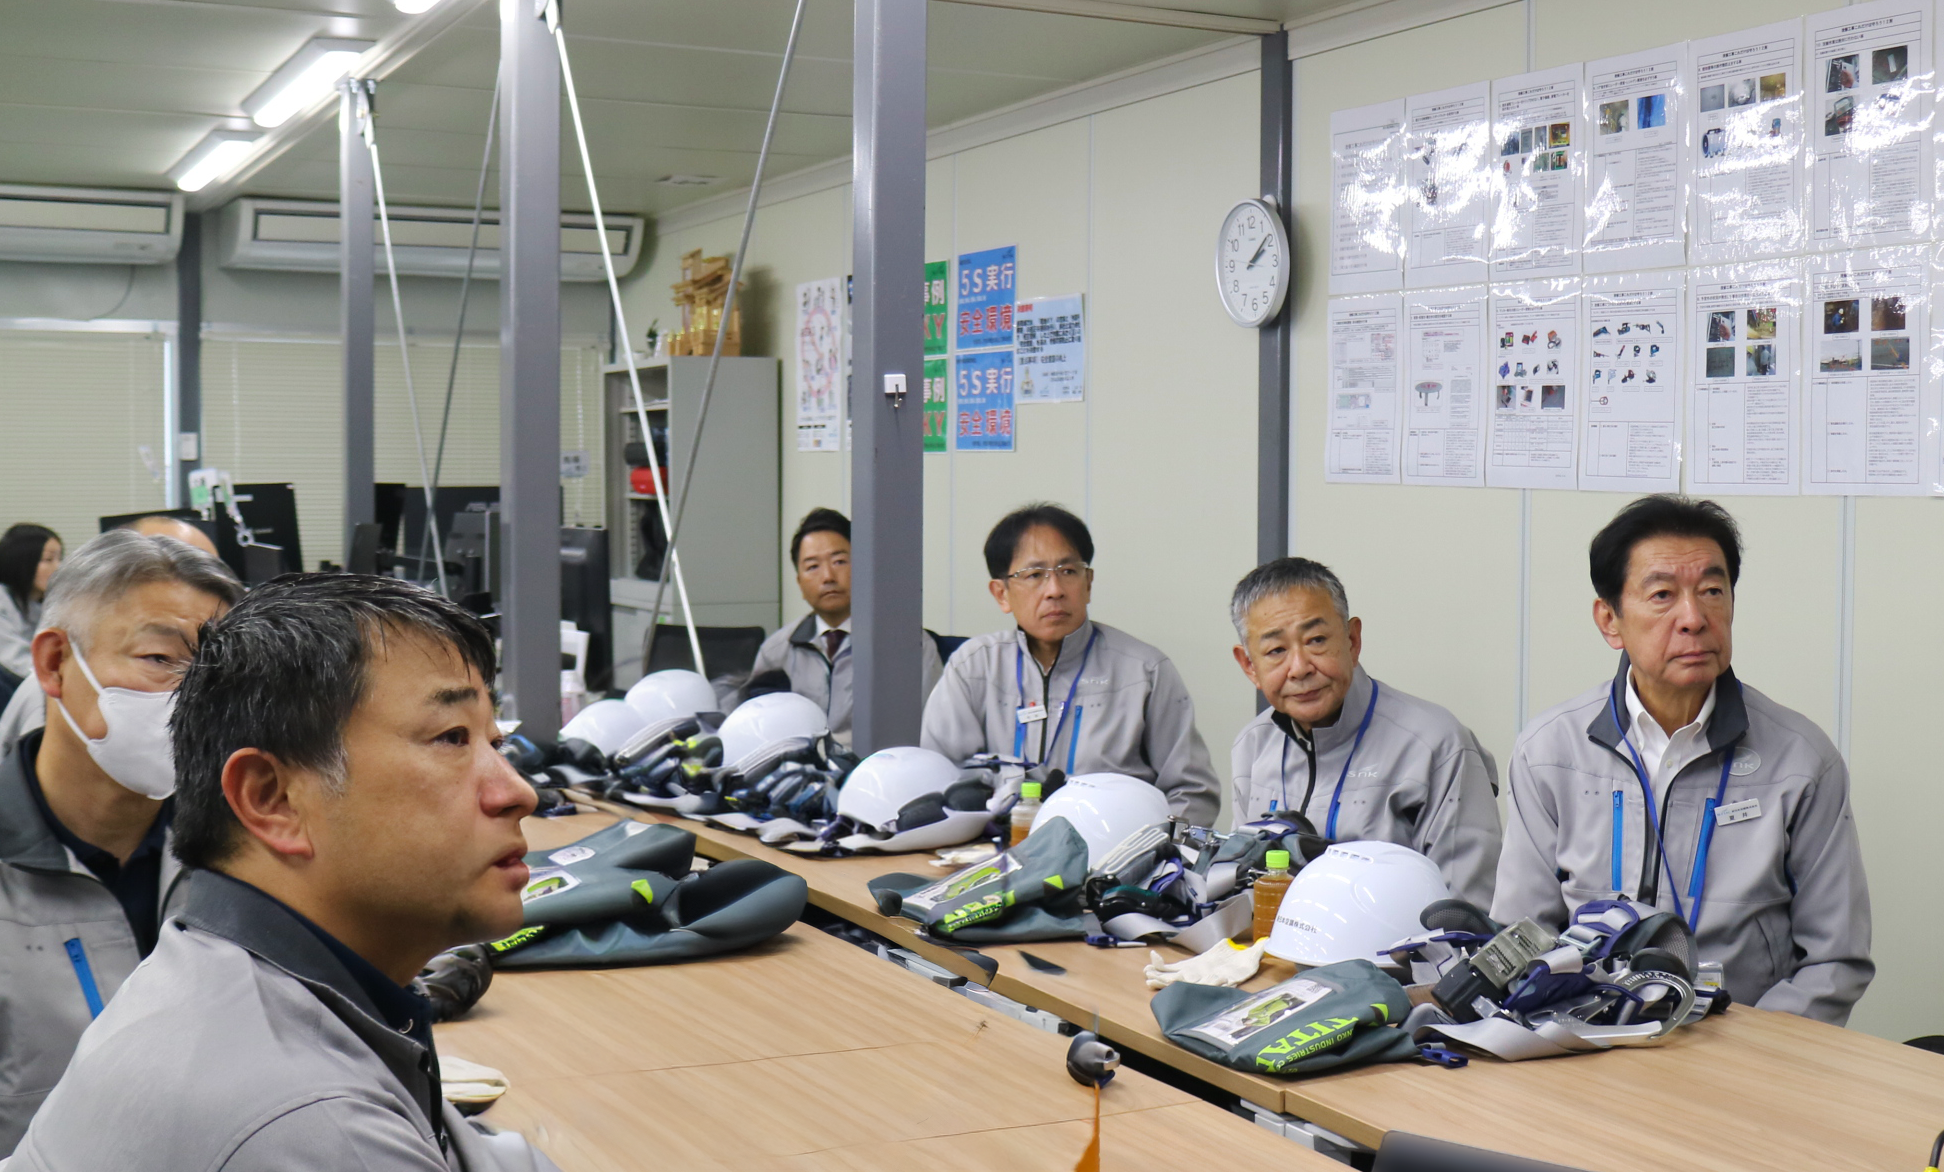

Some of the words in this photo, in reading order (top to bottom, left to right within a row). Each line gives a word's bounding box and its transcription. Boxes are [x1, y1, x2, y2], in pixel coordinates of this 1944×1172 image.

[1247, 215, 1256, 229] 12
[1238, 223, 1245, 236] 11
[1231, 239, 1239, 252] 10
[1267, 234, 1274, 248] 2
[1229, 260, 1235, 273] 9
[1272, 254, 1278, 267] 3
[961, 262, 1014, 296] 5S実行
[1269, 275, 1276, 288] 4
[1233, 280, 1239, 293] 8
[1241, 293, 1247, 307] 7
[1262, 291, 1269, 304] 5
[1252, 298, 1258, 312] 6
[960, 303, 1013, 337] 安全環境
[959, 367, 1013, 397] 5S実行
[959, 409, 1012, 437] 安全環境
[1276, 915, 1318, 935] 日本空調株式会社
[1285, 1038, 1335, 1063] INDUSTRIES
